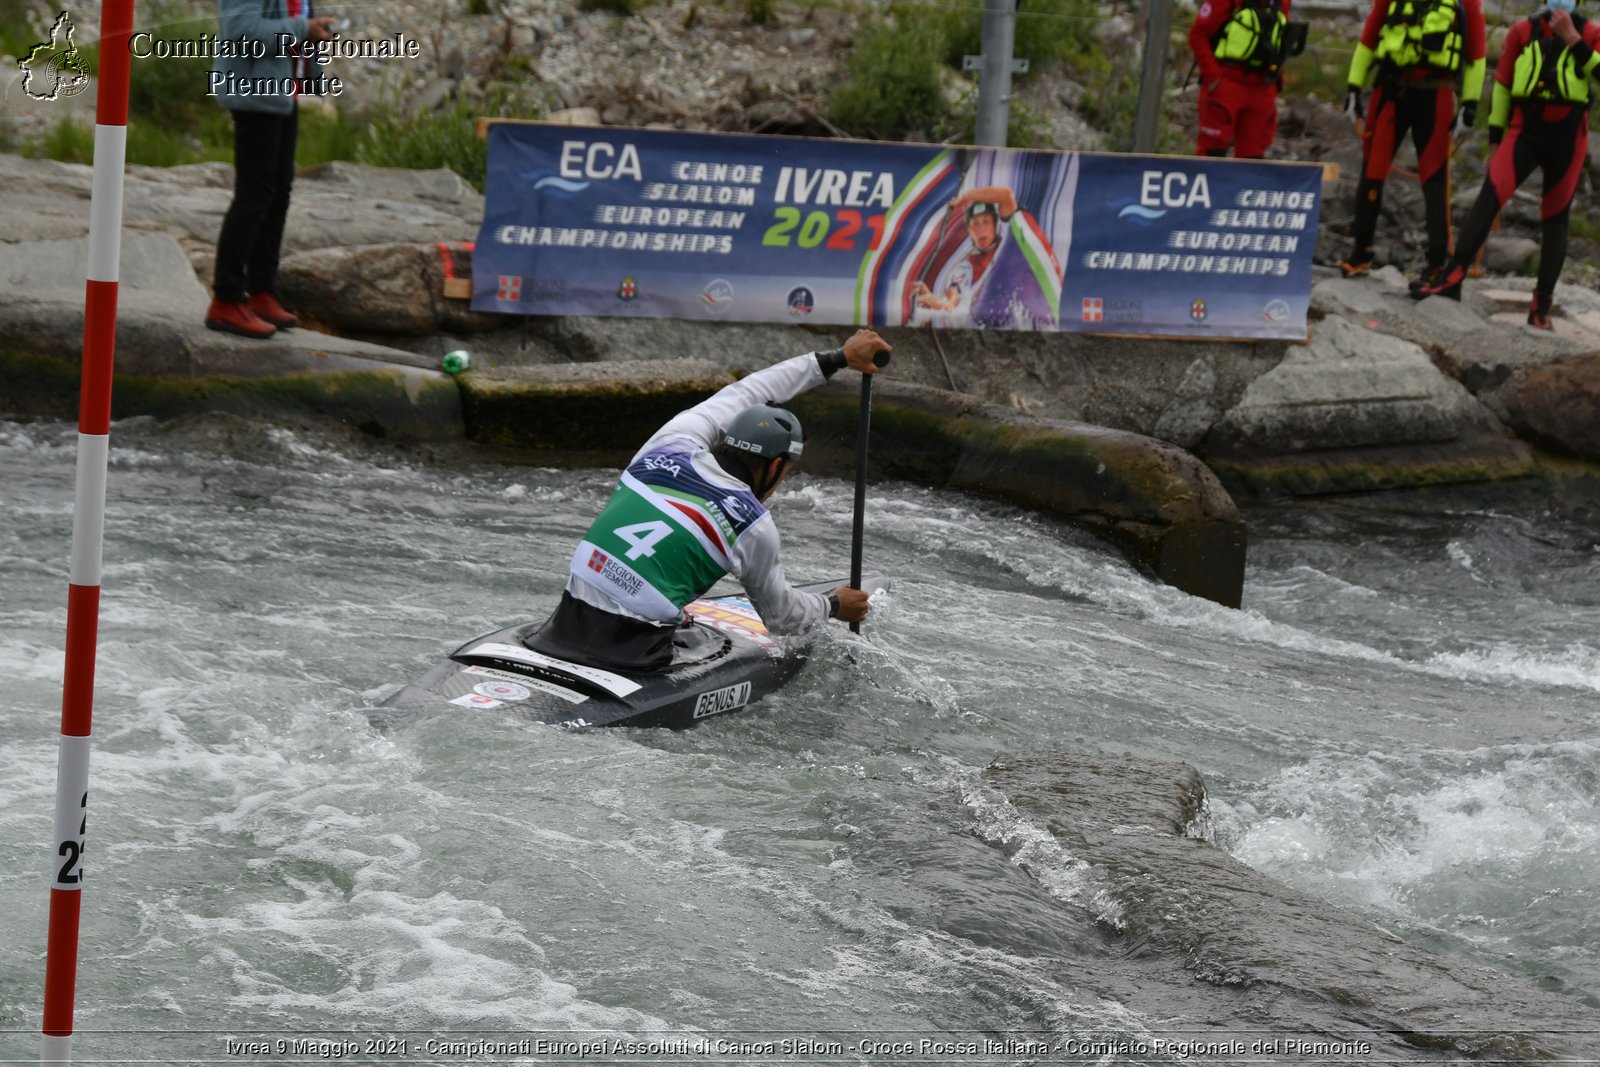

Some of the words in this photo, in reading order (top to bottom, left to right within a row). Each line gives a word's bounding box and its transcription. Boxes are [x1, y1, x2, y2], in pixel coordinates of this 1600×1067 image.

[559, 140, 642, 182] ECA
[676, 161, 764, 185] CANOE
[647, 183, 756, 206] SLALOM
[773, 166, 896, 208] IVREA
[1140, 170, 1211, 209] ECA
[1239, 190, 1316, 211] CANOE
[602, 205, 746, 230] EUROPEAN
[762, 206, 888, 251] 2021
[1215, 209, 1307, 230] SLALOM
[500, 225, 734, 254] CHAMPIONSHIPS
[1174, 231, 1299, 253] EUROPEAN
[1088, 251, 1291, 276] CHAMPIONSHIPS
[653, 454, 681, 477] ECA
[612, 520, 675, 562] 4
[601, 567, 639, 598] PIEMONTE
[605, 559, 645, 590] REGIONE
[57, 839, 85, 884] 2
